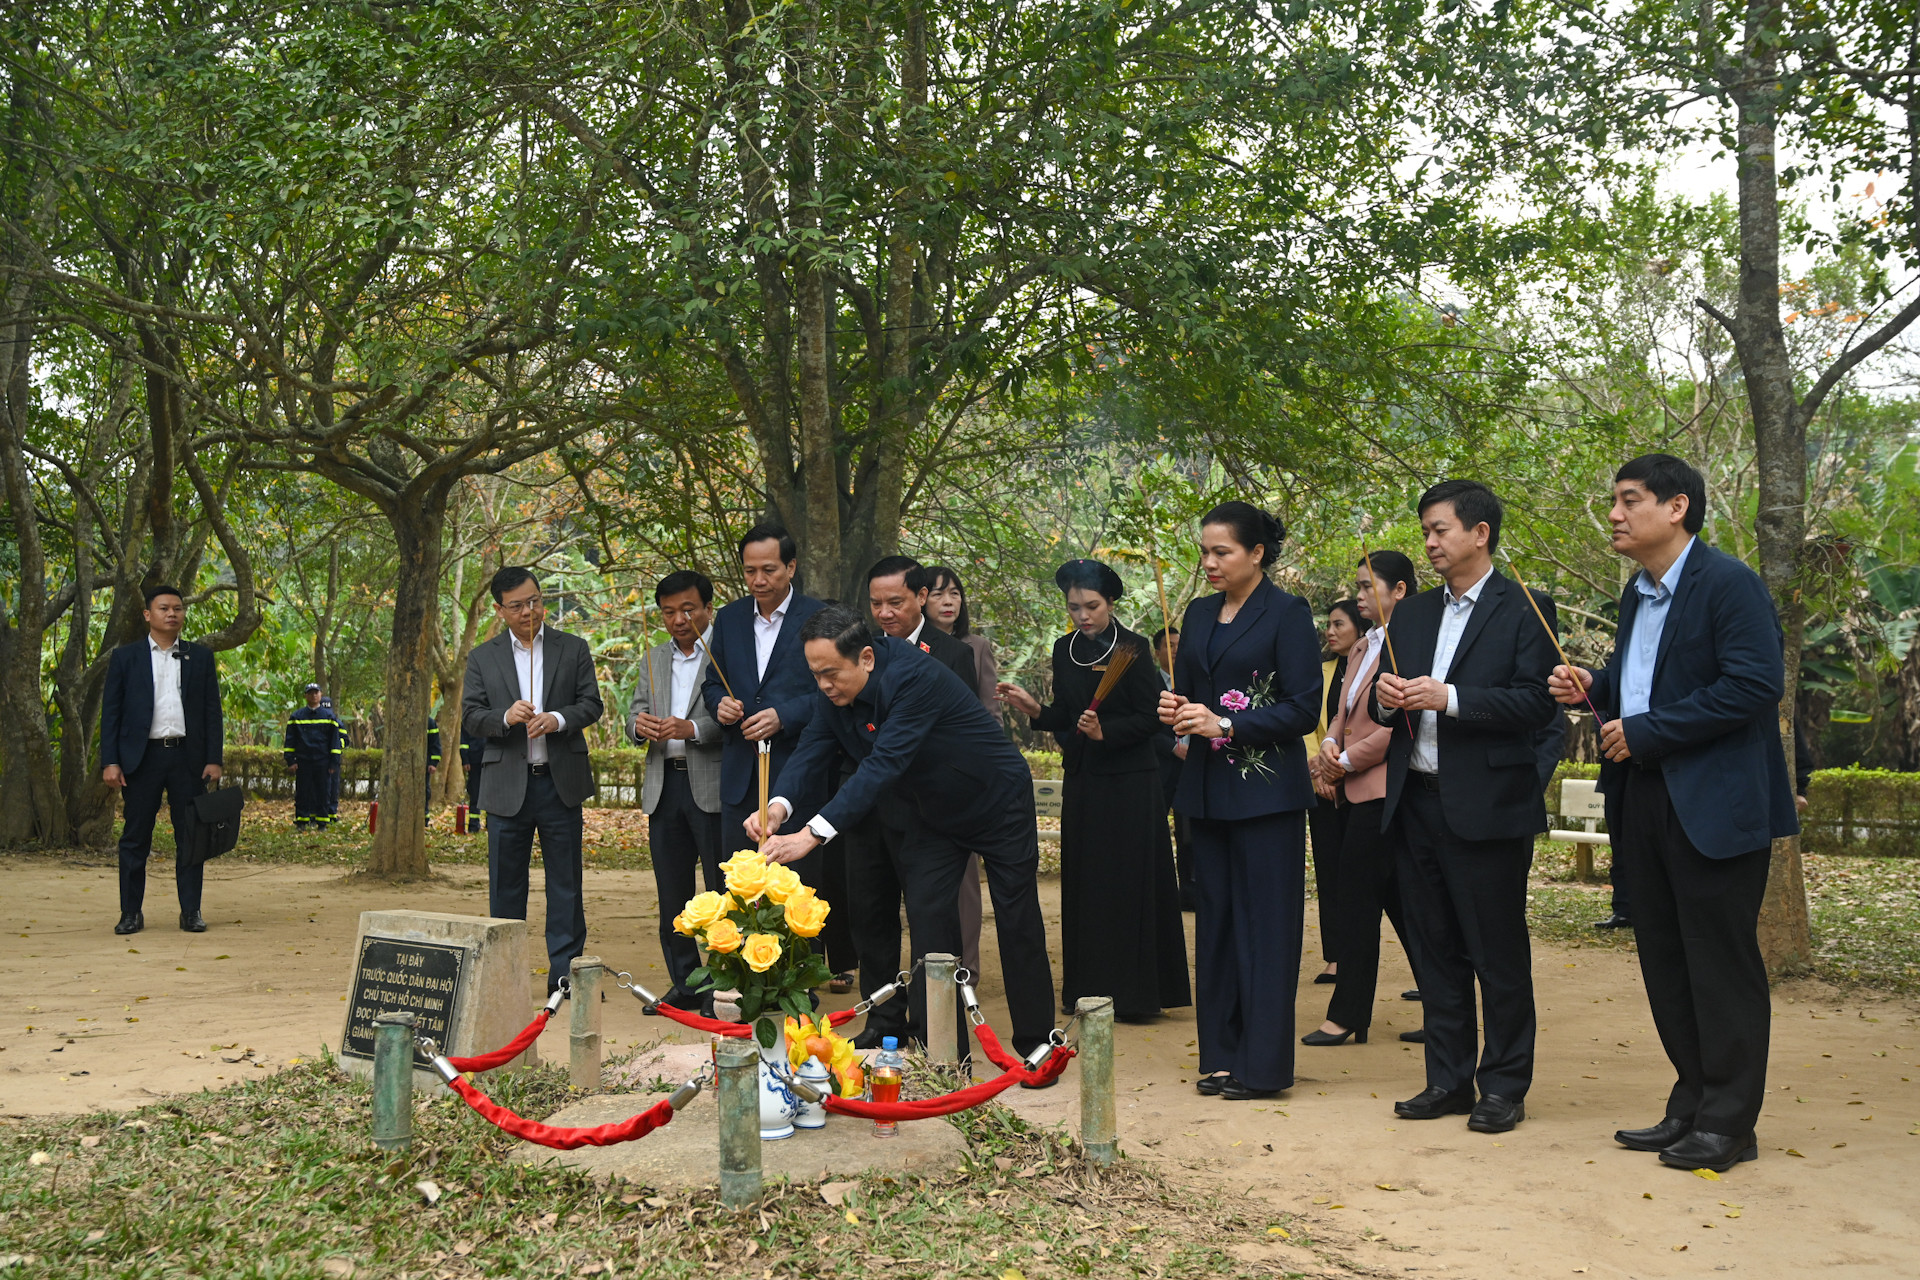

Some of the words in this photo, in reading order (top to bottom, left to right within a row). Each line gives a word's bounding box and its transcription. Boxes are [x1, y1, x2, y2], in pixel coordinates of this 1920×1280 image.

[396, 952, 408, 967] TẠI
[408, 952, 425, 968] ĐÂY
[361, 967, 386, 982] TRƯỚC
[386, 969, 408, 985] QUỐC
[408, 972, 425, 988] DÂN
[425, 976, 439, 992] ĐẠI
[439, 976, 454, 994] HỘI
[363, 985, 380, 1001] CHỦ
[380, 990, 397, 1005] TỊCH
[397, 989, 409, 1006] HỒ
[409, 993, 424, 1008] CHÍ
[423, 997, 444, 1011] MINH
[355, 1007, 372, 1020] ĐỌC
[427, 1015, 444, 1031] TÂM
[351, 1023, 374, 1040] GIÀNH
